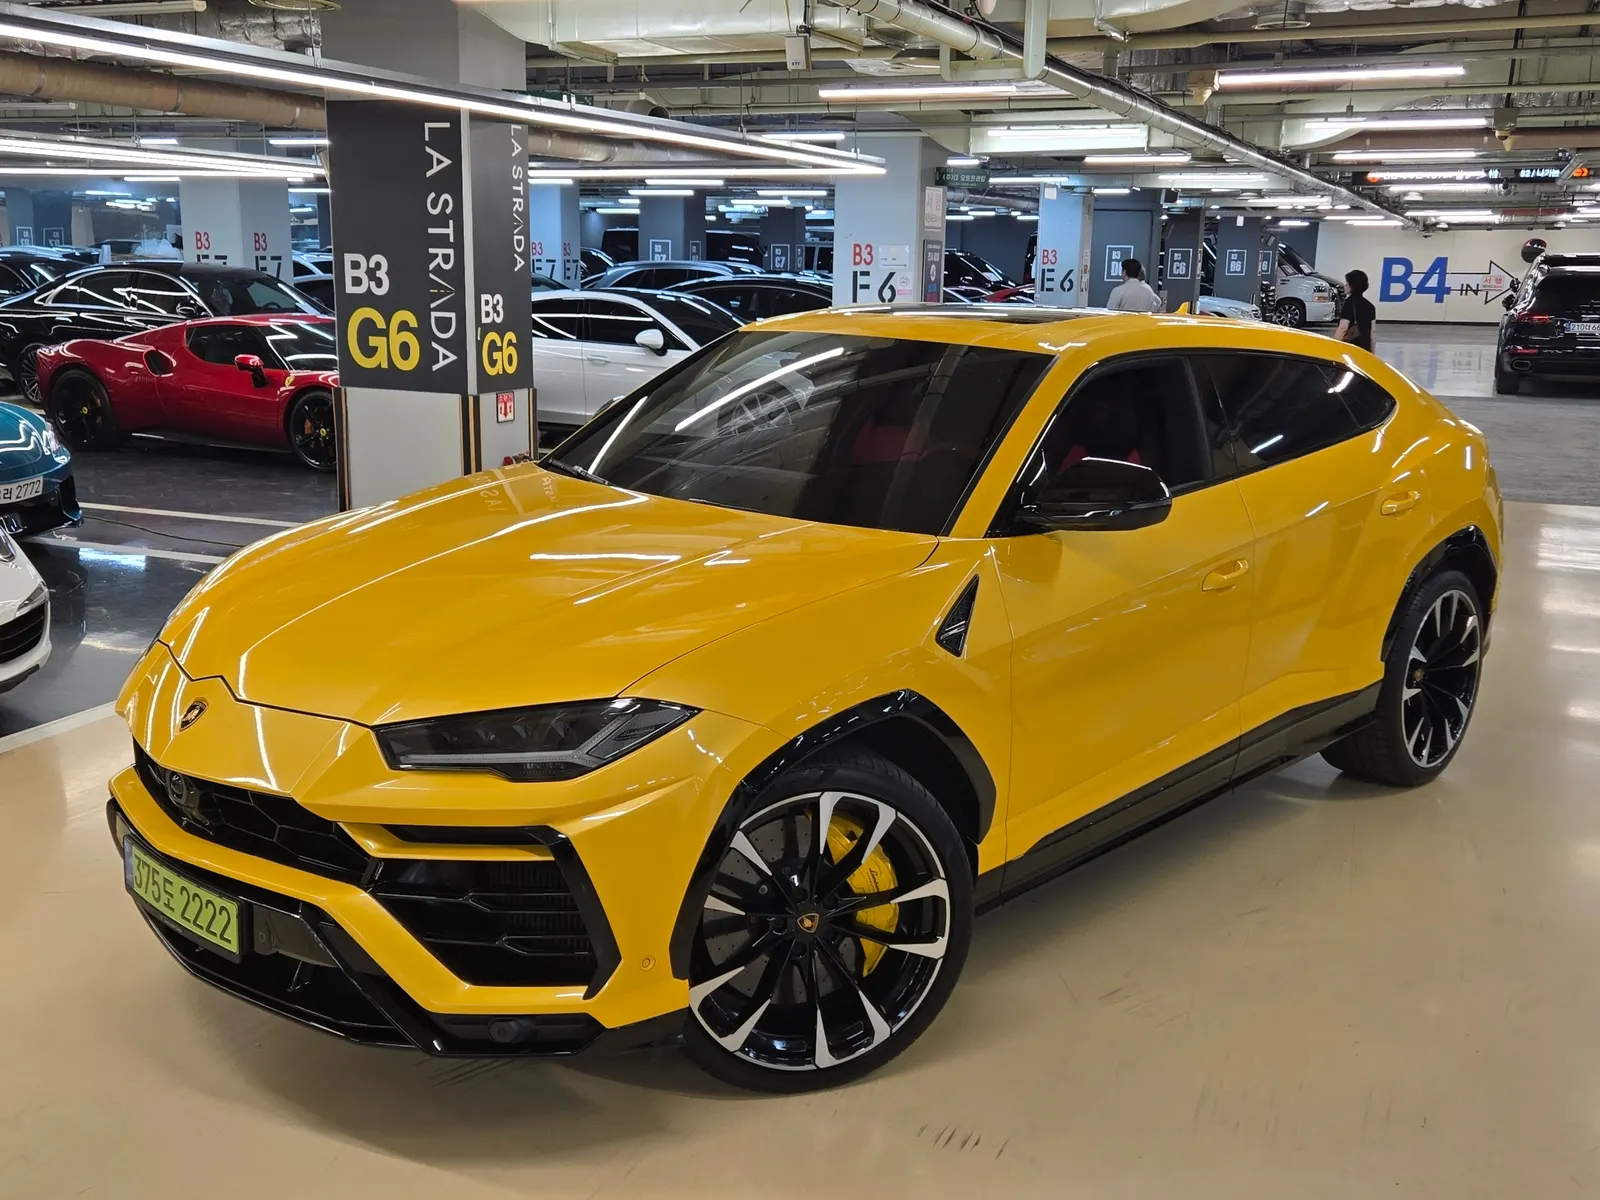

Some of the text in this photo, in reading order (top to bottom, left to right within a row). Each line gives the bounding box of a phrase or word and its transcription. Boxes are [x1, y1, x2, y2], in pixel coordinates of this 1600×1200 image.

[511, 124, 525, 272] LA STRADA
[195, 231, 210, 250] B3
[253, 232, 267, 251] B3
[424, 122, 458, 372] LA STRADA
[531, 241, 543, 256] B3
[852, 243, 874, 266] B3
[1042, 249, 1058, 265] B3
[343, 253, 390, 296] B3
[1040, 268, 1075, 293] E6
[1172, 262, 1186, 275] C6
[1379, 256, 1452, 303] B4
[852, 270, 897, 304] F6
[1460, 283, 1480, 296] IN
[480, 294, 504, 324] B3
[347, 307, 420, 371] G6
[482, 331, 518, 376] G6
[0, 480, 41, 500] 러 2772
[133, 853, 232, 945] 375도 2222
